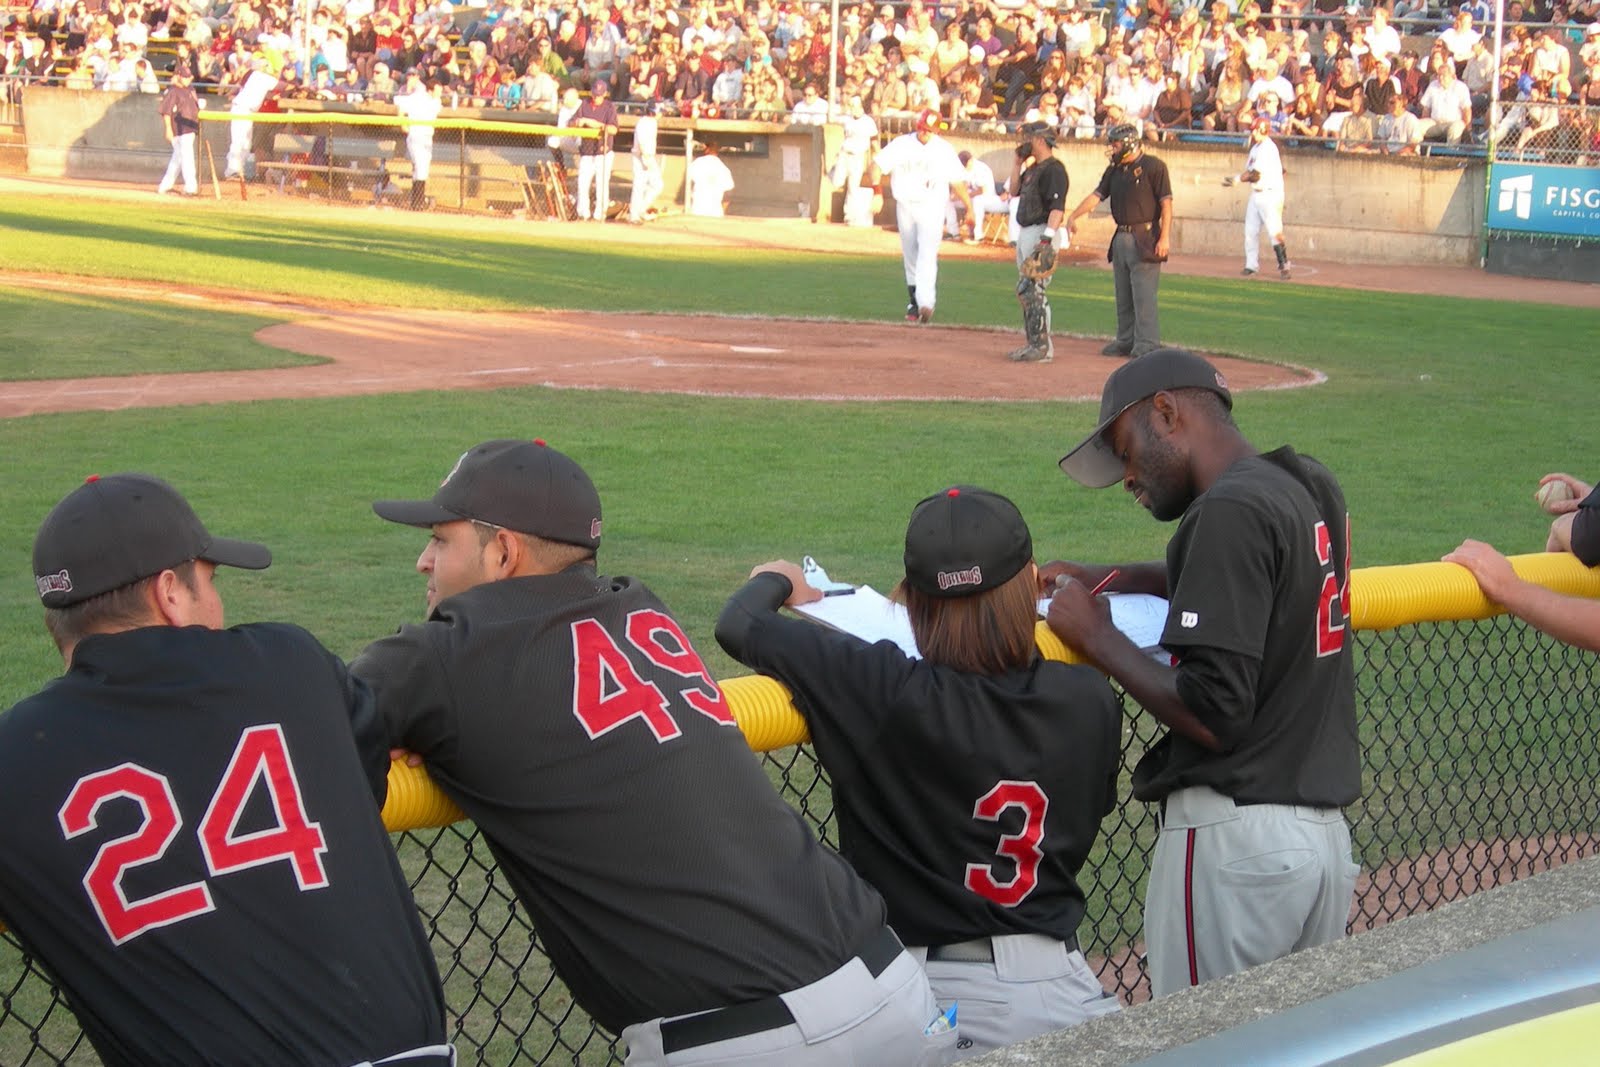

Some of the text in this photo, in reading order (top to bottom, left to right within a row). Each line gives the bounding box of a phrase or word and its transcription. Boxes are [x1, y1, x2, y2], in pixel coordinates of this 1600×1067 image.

[1546, 186, 1600, 208] FISG
[1552, 209, 1585, 218] CAPITAL
[1314, 511, 1350, 658] 2
[570, 608, 737, 744] 49
[57, 723, 330, 947] 24
[964, 780, 1049, 908] 3
